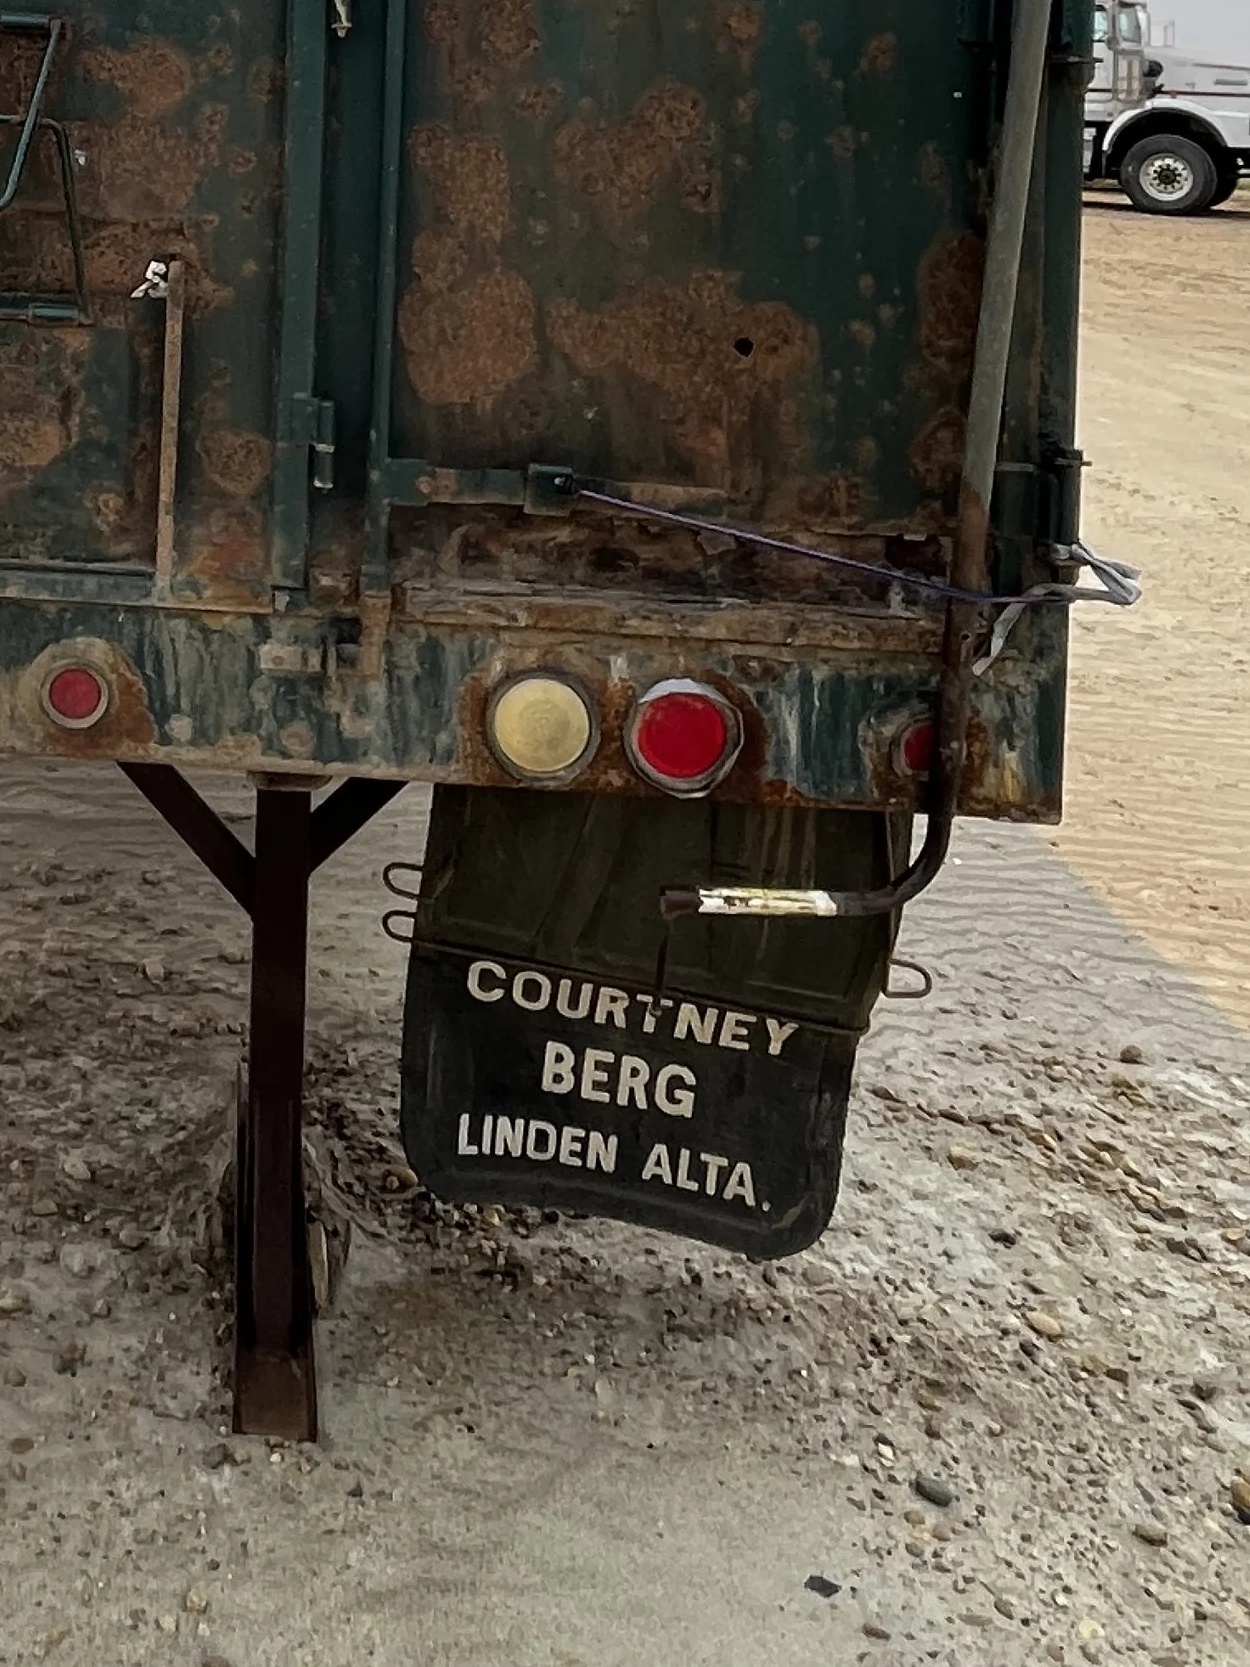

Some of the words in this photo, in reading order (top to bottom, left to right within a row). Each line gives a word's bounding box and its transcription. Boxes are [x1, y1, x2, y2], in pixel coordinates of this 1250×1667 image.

[467, 960, 799, 1056] COURTNEY
[541, 1040, 698, 1119] BERG
[457, 1113, 618, 1174] LINDEN
[642, 1143, 771, 1213] ALTA.
